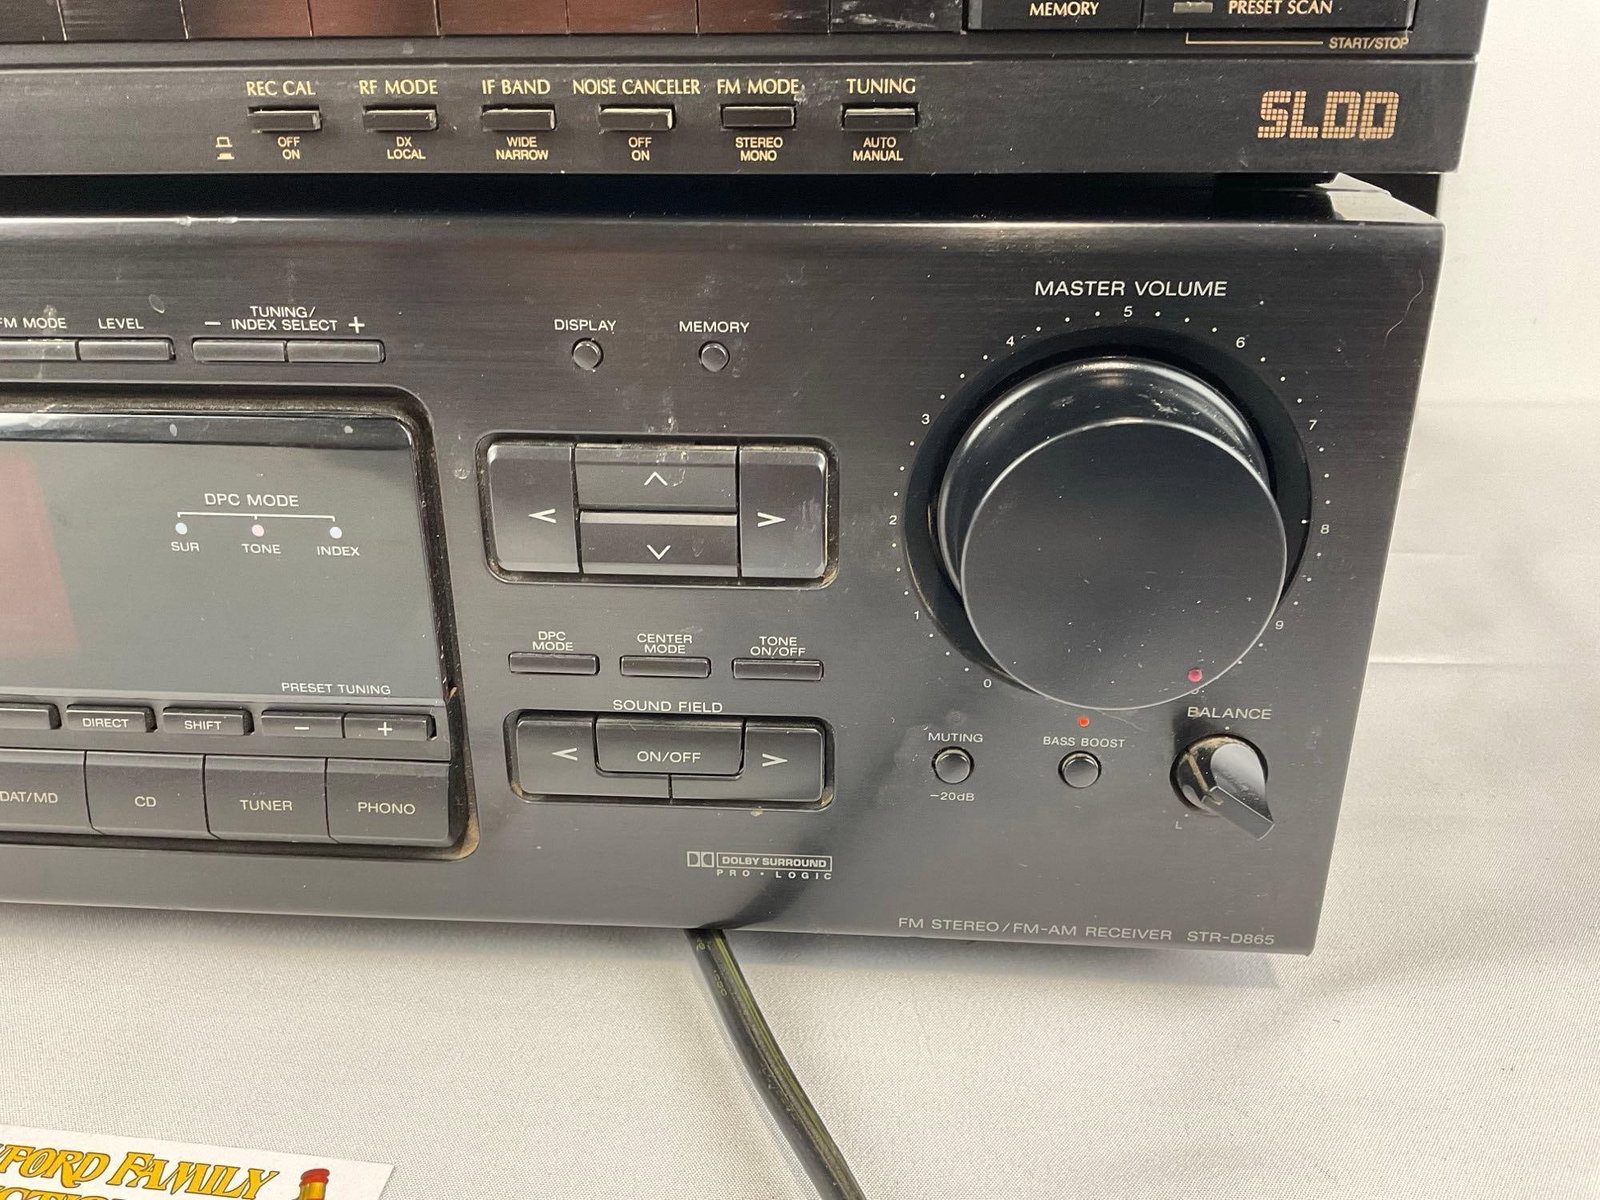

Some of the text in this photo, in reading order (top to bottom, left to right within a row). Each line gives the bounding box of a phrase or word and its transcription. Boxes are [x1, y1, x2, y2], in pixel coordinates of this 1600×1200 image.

[1029, 1, 1100, 17] MEMORY
[1228, 0, 1333, 15] PRESET SCAN
[1328, 36, 1410, 50] START/STOP
[246, 80, 316, 97] REC CAL
[358, 79, 439, 95] RF MODE
[481, 79, 551, 95] IF BAND
[572, 79, 701, 95] NOISE CANCELER
[716, 79, 799, 95] FM MODE
[846, 78, 916, 94] TUNING
[277, 136, 300, 148] OFF
[396, 136, 412, 148] DX
[506, 136, 537, 148] WIDE
[628, 136, 652, 148] OFF
[735, 136, 784, 149] STEREO
[863, 136, 897, 149] AUTO
[282, 149, 301, 161] ON
[386, 149, 426, 161] LOCAL
[495, 149, 549, 162] NARROW
[631, 150, 650, 162] ON
[740, 150, 777, 162] MONO
[852, 150, 904, 162] MANUAL
[1034, 279, 1228, 298] MASTER VOLUME
[249, 305, 316, 319] TUNING/
[1123, 305, 1134, 318] 5
[22, 317, 68, 329] MODE
[98, 318, 144, 331] LEVEL
[231, 318, 338, 332] INDEX SELECT
[553, 319, 617, 332] DISPLAY
[678, 320, 750, 334] MEMORY
[1005, 335, 1016, 348] 4
[1234, 336, 1246, 349] 6
[920, 413, 931, 426] 3
[1308, 419, 1319, 431] 7
[204, 492, 300, 508] DPC MODE
[887, 514, 898, 526] 2
[1319, 523, 1331, 536] 8
[170, 541, 201, 553] SUR
[241, 543, 282, 555] TONE
[316, 545, 361, 557] INDEX
[912, 610, 921, 622] 1
[1274, 619, 1285, 631] 9
[537, 631, 567, 642] DPC
[636, 633, 693, 645] CENTER
[758, 636, 798, 648] TONE
[532, 641, 574, 652] MODE
[643, 644, 687, 655] MODE
[749, 646, 806, 658] ON/OFF
[281, 682, 392, 697] PRESET TUNING
[982, 678, 993, 690] 0
[612, 699, 723, 714] SOUND FIELD
[1186, 705, 1273, 721] BALANCE
[82, 717, 130, 730] DIRECT
[184, 720, 222, 732] SHIFT
[927, 731, 984, 744] MUTING
[1042, 735, 1126, 749] BASS BOOST
[636, 750, 702, 765] ON/OFF
[0, 790, 59, 804] DAT/MD
[134, 795, 157, 808] CD
[929, 791, 976, 803] -20dB
[239, 798, 293, 813] TUNER
[357, 801, 416, 816] PHONO
[1175, 820, 1183, 830] L
[722, 855, 827, 868] DOLBY SURROUND
[716, 868, 832, 881] PRO LOGIC
[898, 917, 924, 929] FM
[1085, 926, 1172, 941] RECEIVER
[1186, 930, 1275, 946] STR-D865
[0, 1143, 280, 1200] FORD FAMILY
